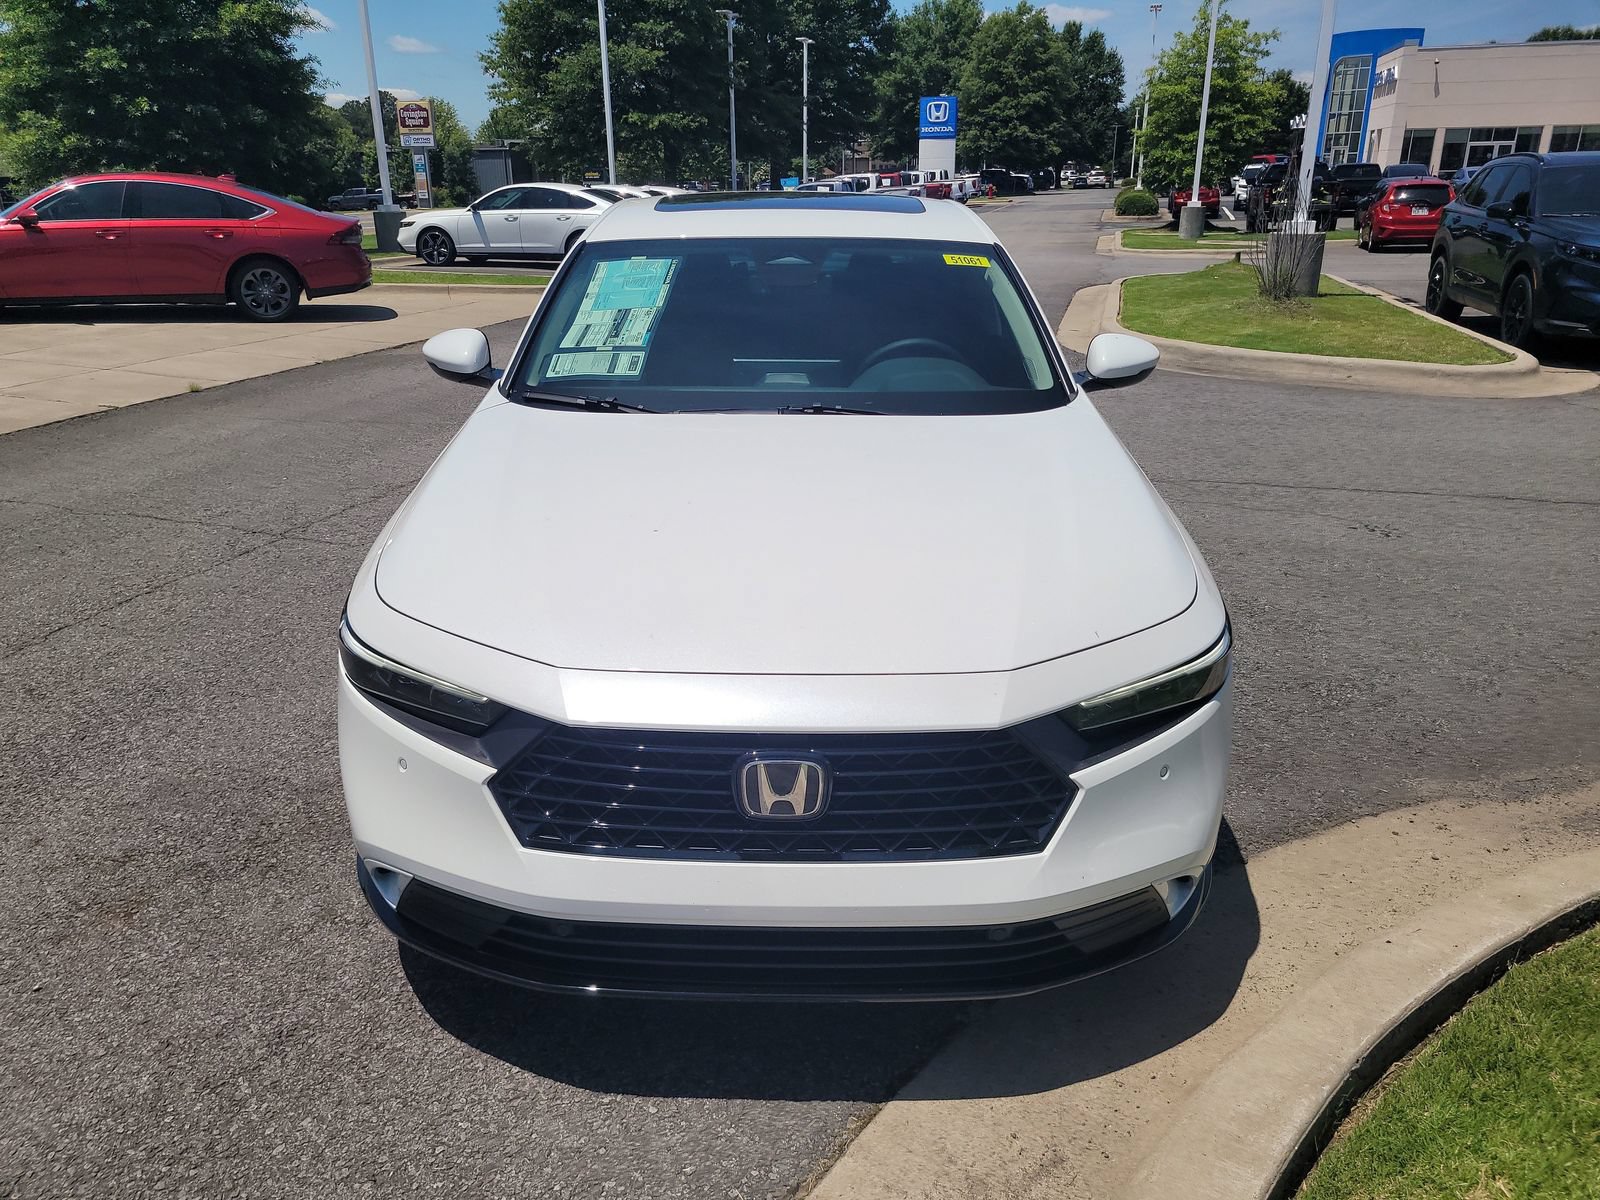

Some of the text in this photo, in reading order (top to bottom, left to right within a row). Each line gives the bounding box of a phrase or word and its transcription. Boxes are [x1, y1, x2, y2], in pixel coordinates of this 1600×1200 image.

[400, 110, 428, 120] Covington
[405, 117, 424, 127] Square
[951, 256, 983, 266] 51061
